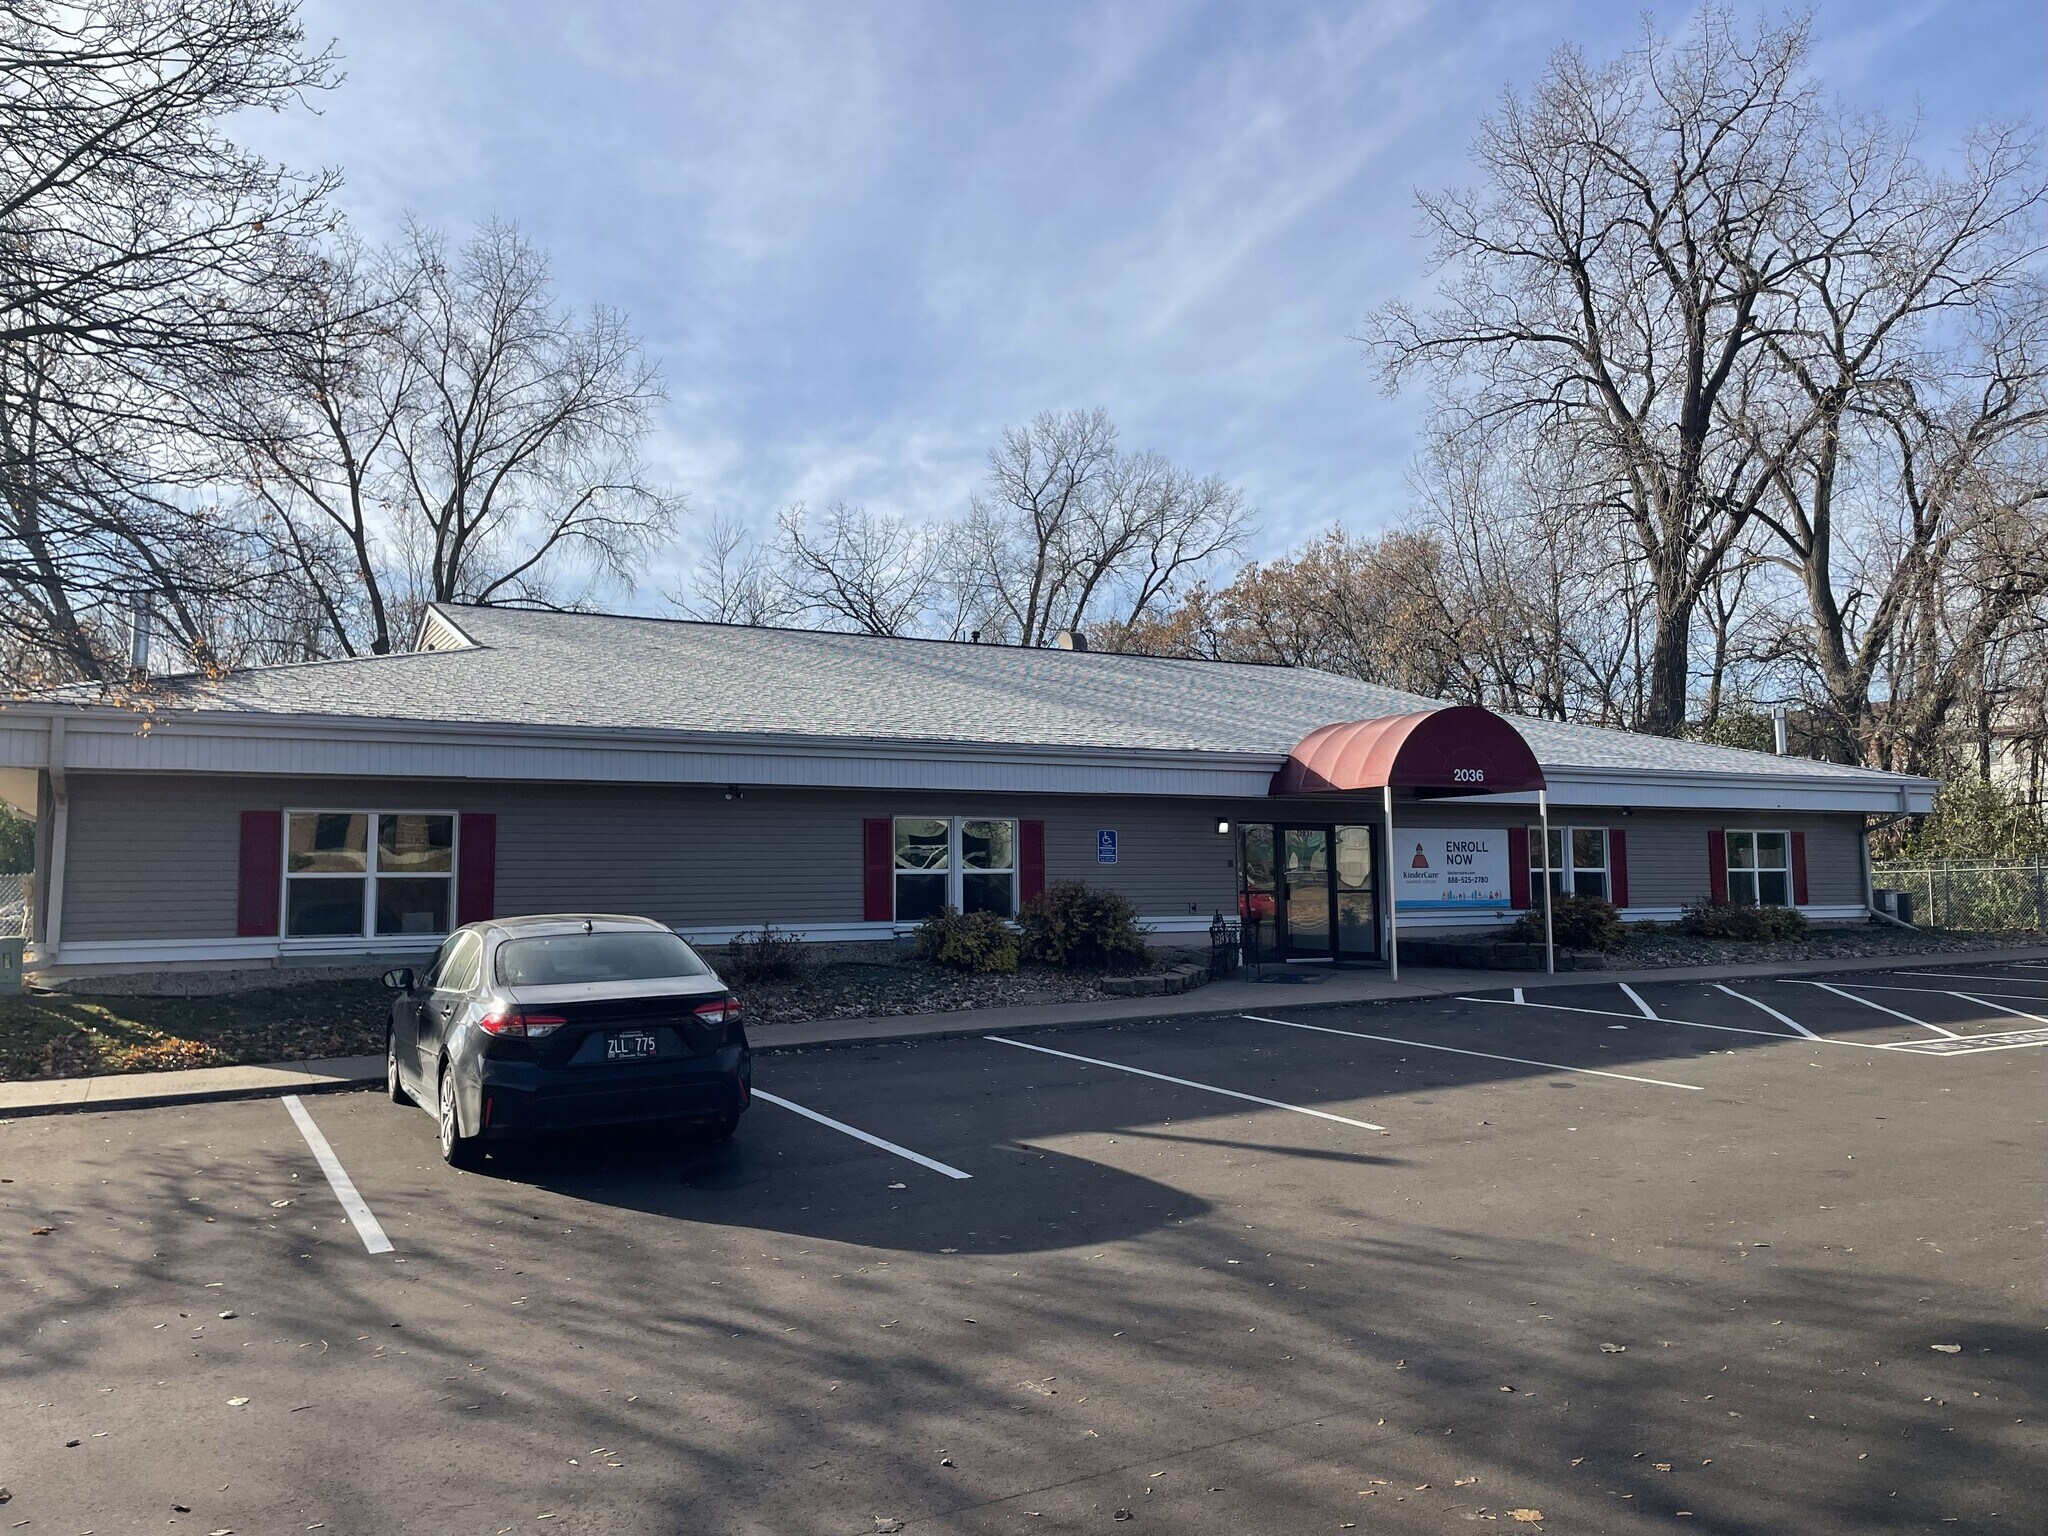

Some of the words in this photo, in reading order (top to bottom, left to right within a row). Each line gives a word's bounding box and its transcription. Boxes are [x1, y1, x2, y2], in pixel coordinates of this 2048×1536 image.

[1453, 768, 1484, 782] 2036
[1446, 841, 1489, 853] ENROLL
[1446, 854, 1473, 866] NOW
[1403, 871, 1439, 879] KinderCare
[1447, 876, 1489, 884] 888-525-2780
[608, 1039, 628, 1053] ZLL
[635, 1037, 655, 1051] 775
